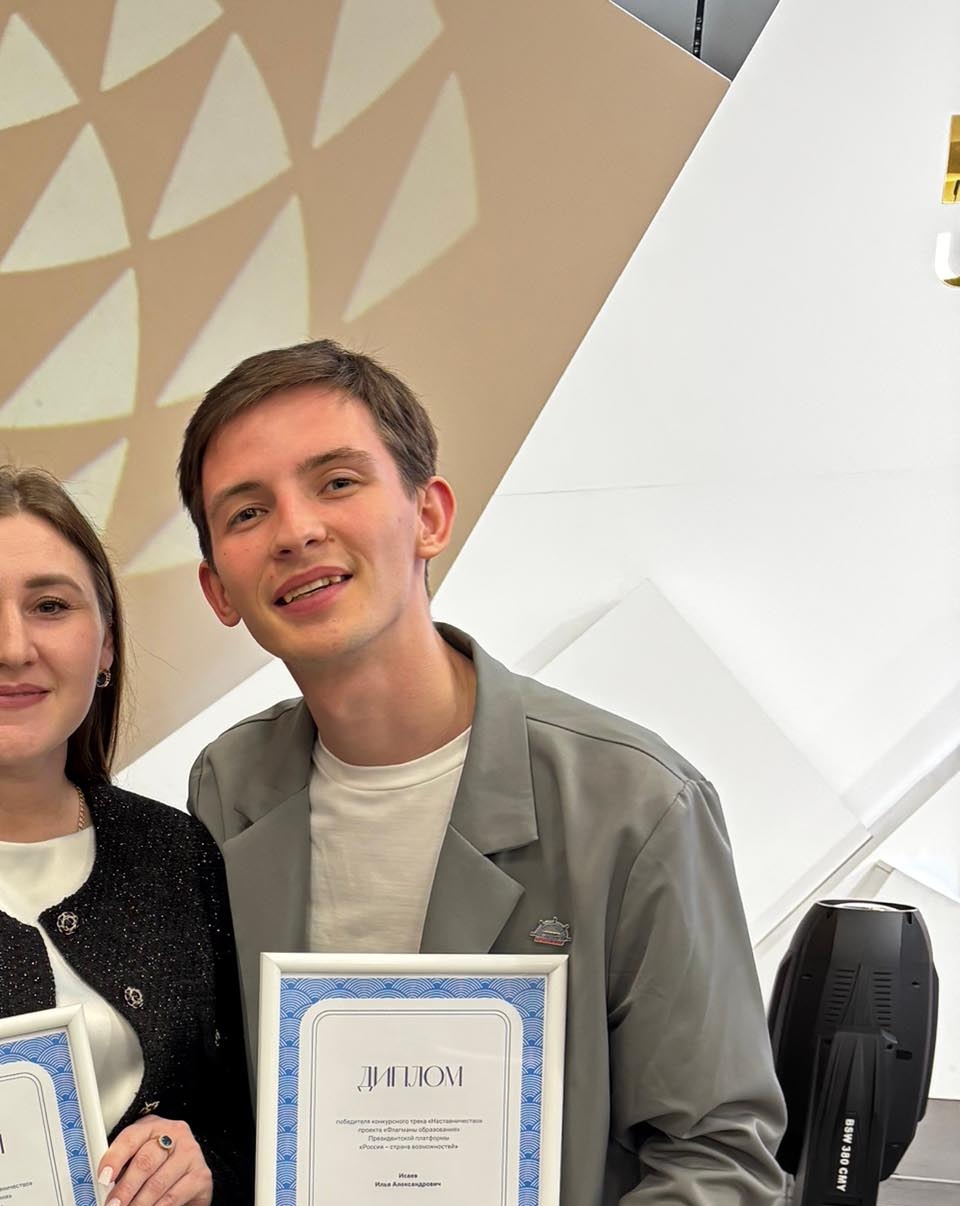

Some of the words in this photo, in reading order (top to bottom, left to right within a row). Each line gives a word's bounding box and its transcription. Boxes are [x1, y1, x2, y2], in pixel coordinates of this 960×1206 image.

[357, 1065, 463, 1092] ДИПЛОМ
[842, 1118, 855, 1144] BSW
[840, 1145, 852, 1166] 380
[836, 1167, 849, 1192] CMY
